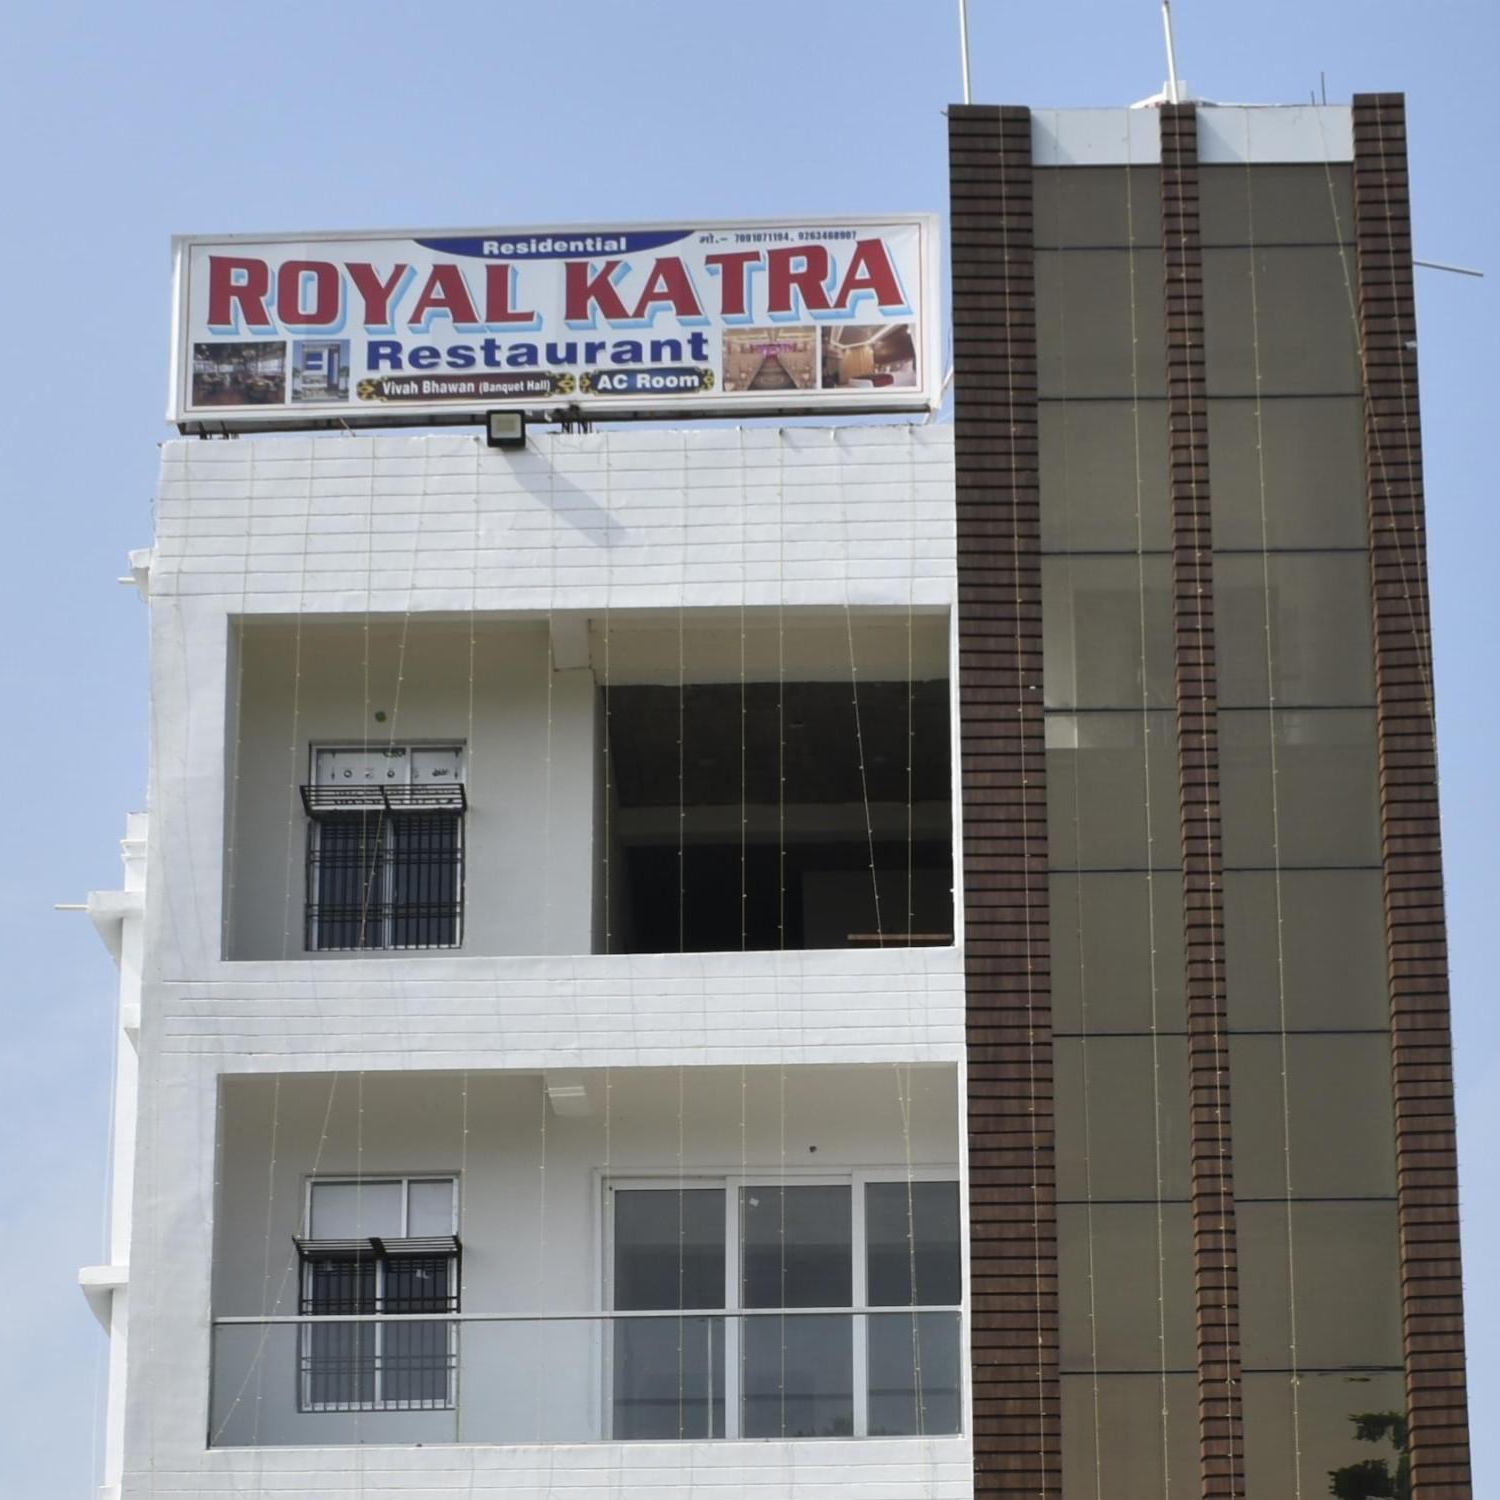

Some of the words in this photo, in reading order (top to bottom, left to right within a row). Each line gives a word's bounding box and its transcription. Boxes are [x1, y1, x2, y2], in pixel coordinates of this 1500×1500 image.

[483, 237, 627, 255] Residential
[207, 254, 540, 328] ROYAL
[564, 239, 908, 327] KATRA
[366, 332, 709, 370] Restaurant
[382, 380, 419, 395] Vivah
[422, 379, 475, 394] Bhawan
[479, 380, 525, 395] (Banquet
[528, 379, 551, 394] Hall)
[597, 375, 628, 389] AC
[636, 373, 700, 389] Room
